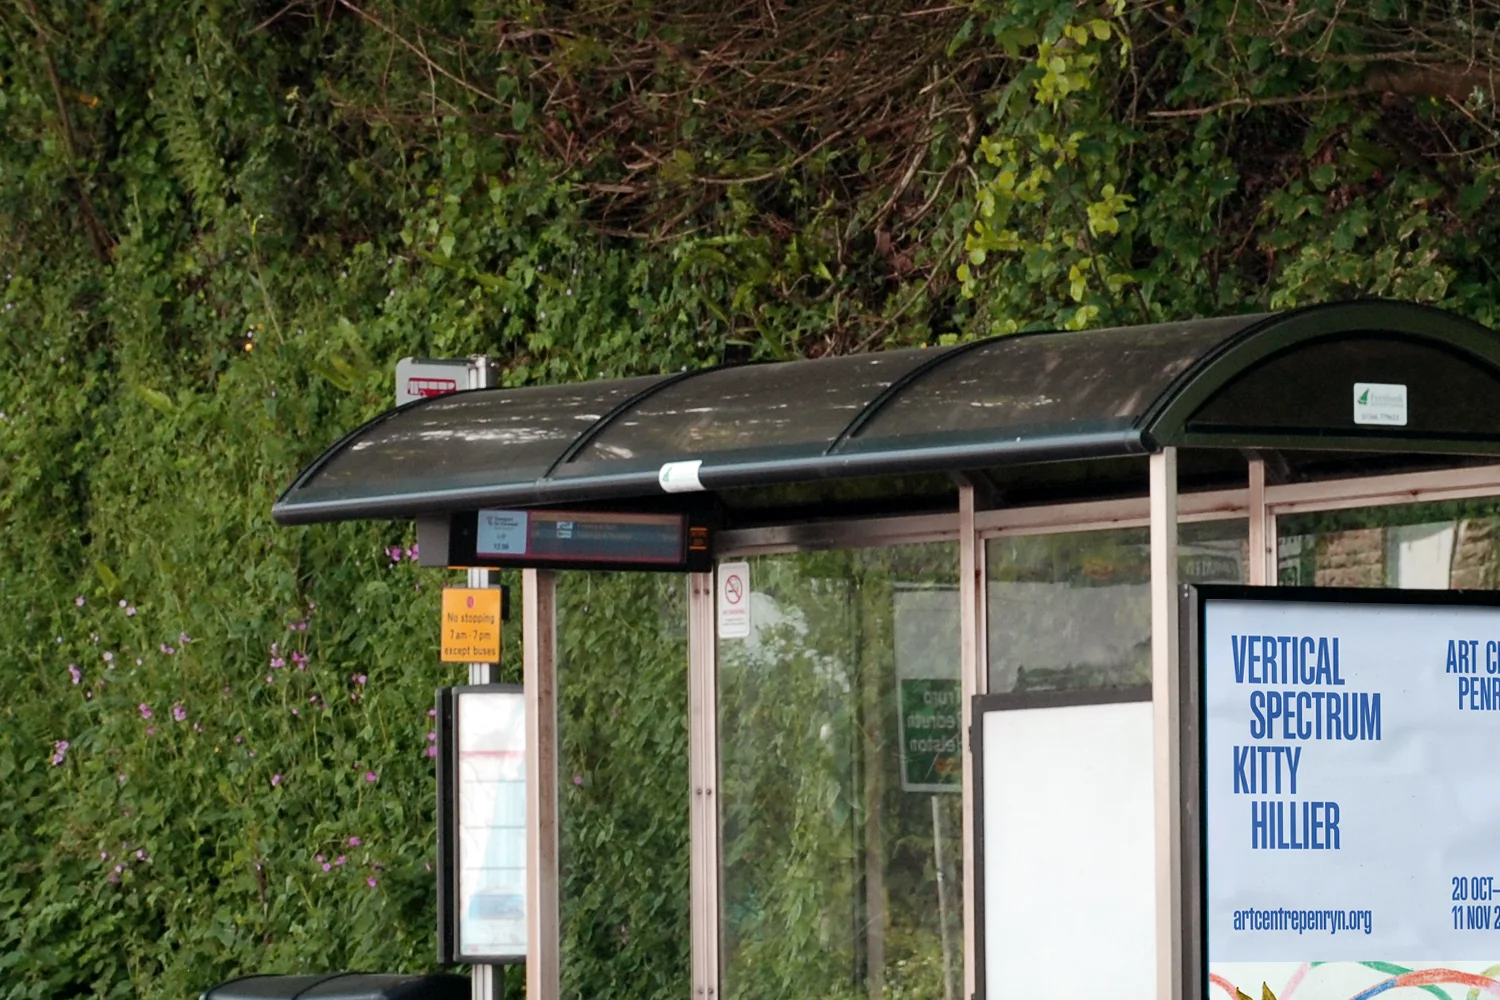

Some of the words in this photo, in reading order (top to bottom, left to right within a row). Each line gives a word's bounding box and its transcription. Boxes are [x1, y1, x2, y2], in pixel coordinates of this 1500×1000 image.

[447, 612, 459, 623] No
[460, 612, 495, 625] stopping
[444, 646, 470, 656] except
[472, 646, 496, 656] buses
[1231, 634, 1346, 686] VERTICAL
[1445, 639, 1479, 674] ART
[1249, 690, 1382, 741] SPECTRUM
[1233, 745, 1302, 795] KITTY
[1251, 801, 1341, 850] HILLIER
[1451, 876, 1468, 901] 20
[1233, 907, 1372, 935] artcentrepenryn.org
[1452, 905, 1463, 930] 11
[1466, 905, 1491, 930] NOV
